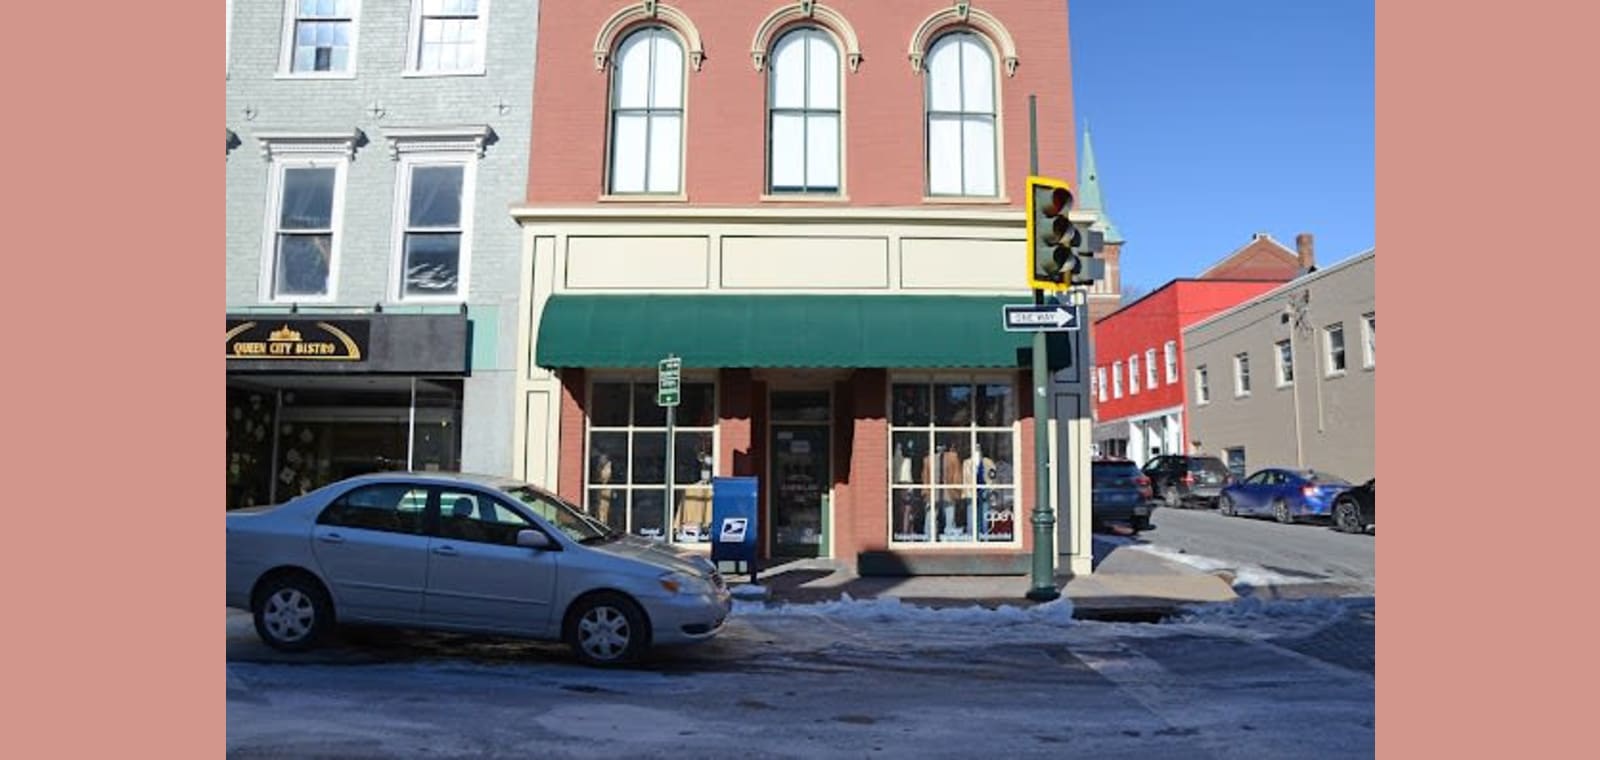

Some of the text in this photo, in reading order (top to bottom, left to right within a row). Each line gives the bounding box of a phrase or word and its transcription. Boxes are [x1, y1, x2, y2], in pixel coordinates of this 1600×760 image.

[1014, 313, 1055, 322] ONE WAY
[233, 342, 336, 355] QUEEN CITY BISTRO
